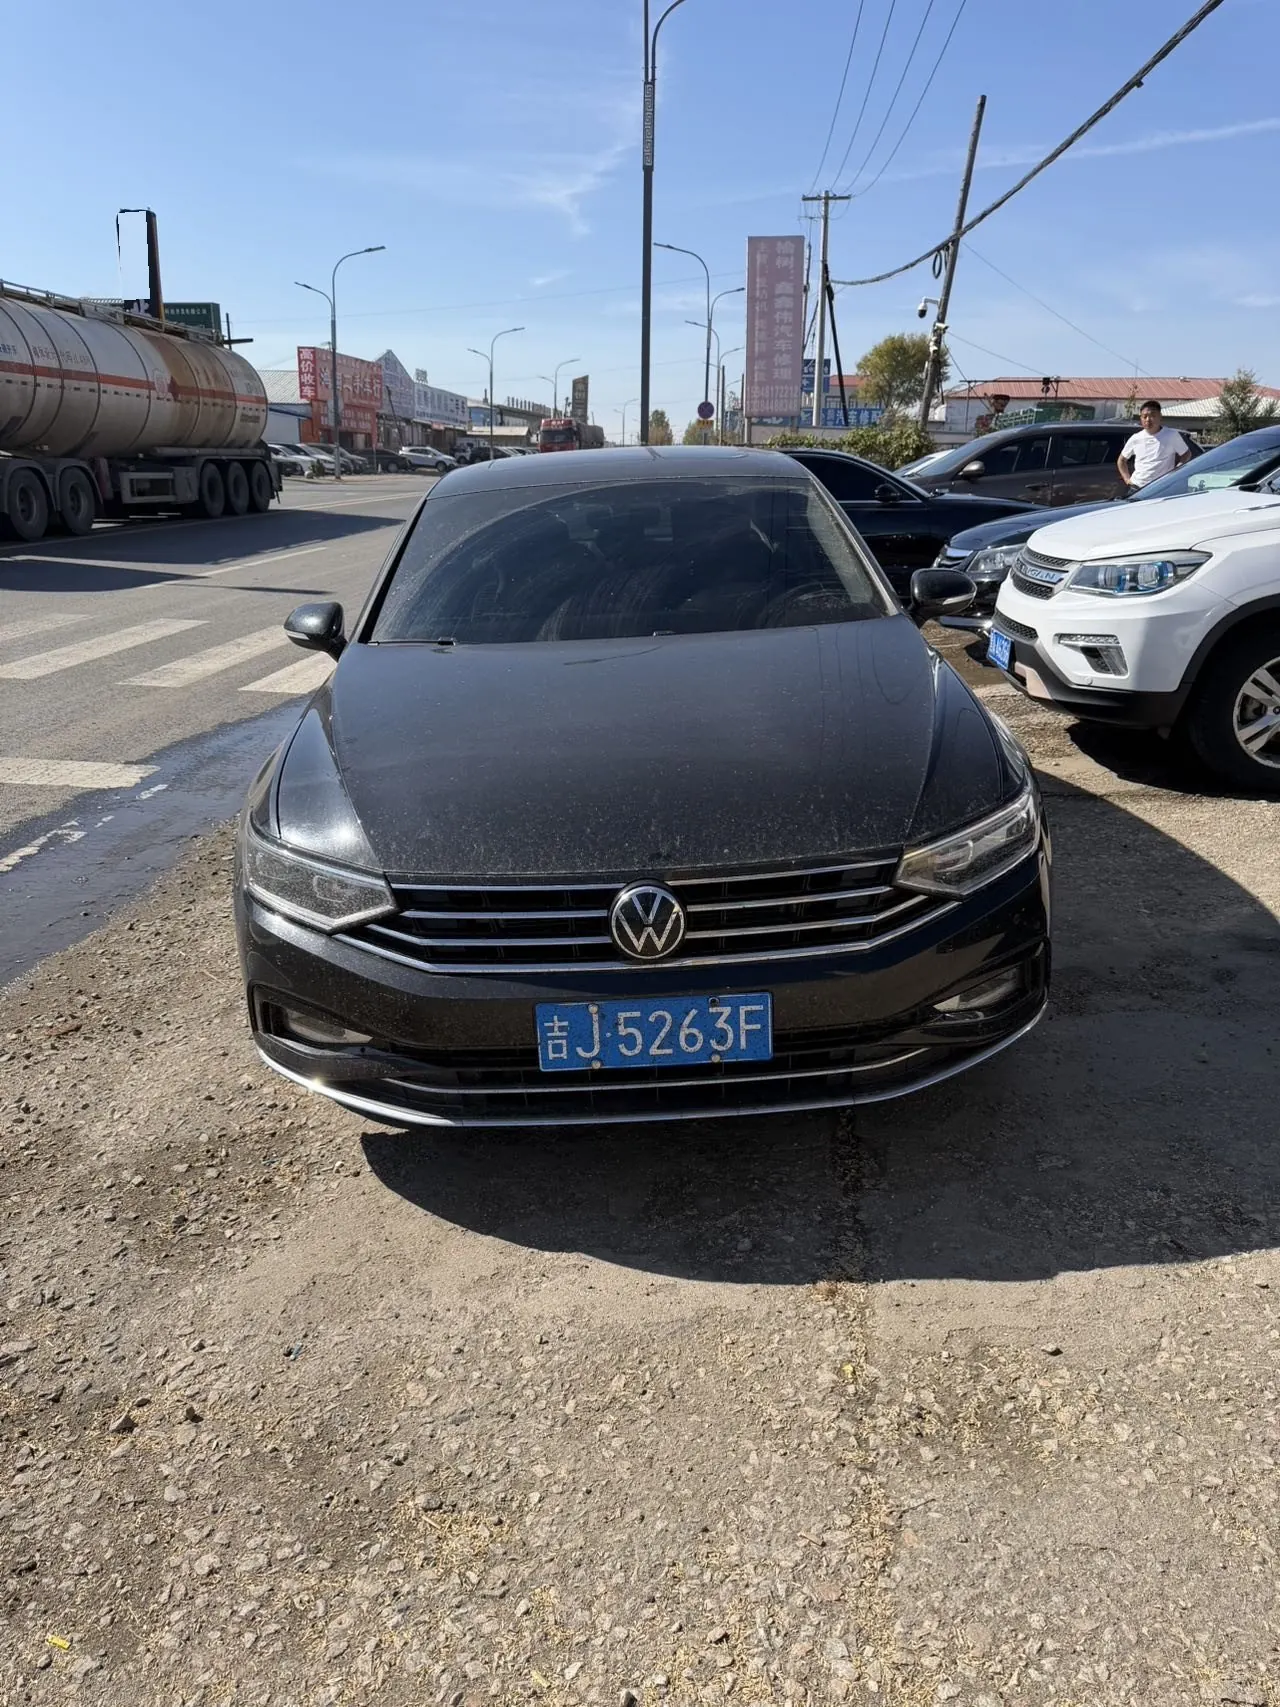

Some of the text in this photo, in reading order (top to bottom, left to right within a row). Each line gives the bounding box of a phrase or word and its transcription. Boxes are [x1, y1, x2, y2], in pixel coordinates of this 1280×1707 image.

[300, 348, 316, 398] 高价收车
[614, 889, 681, 955] VW
